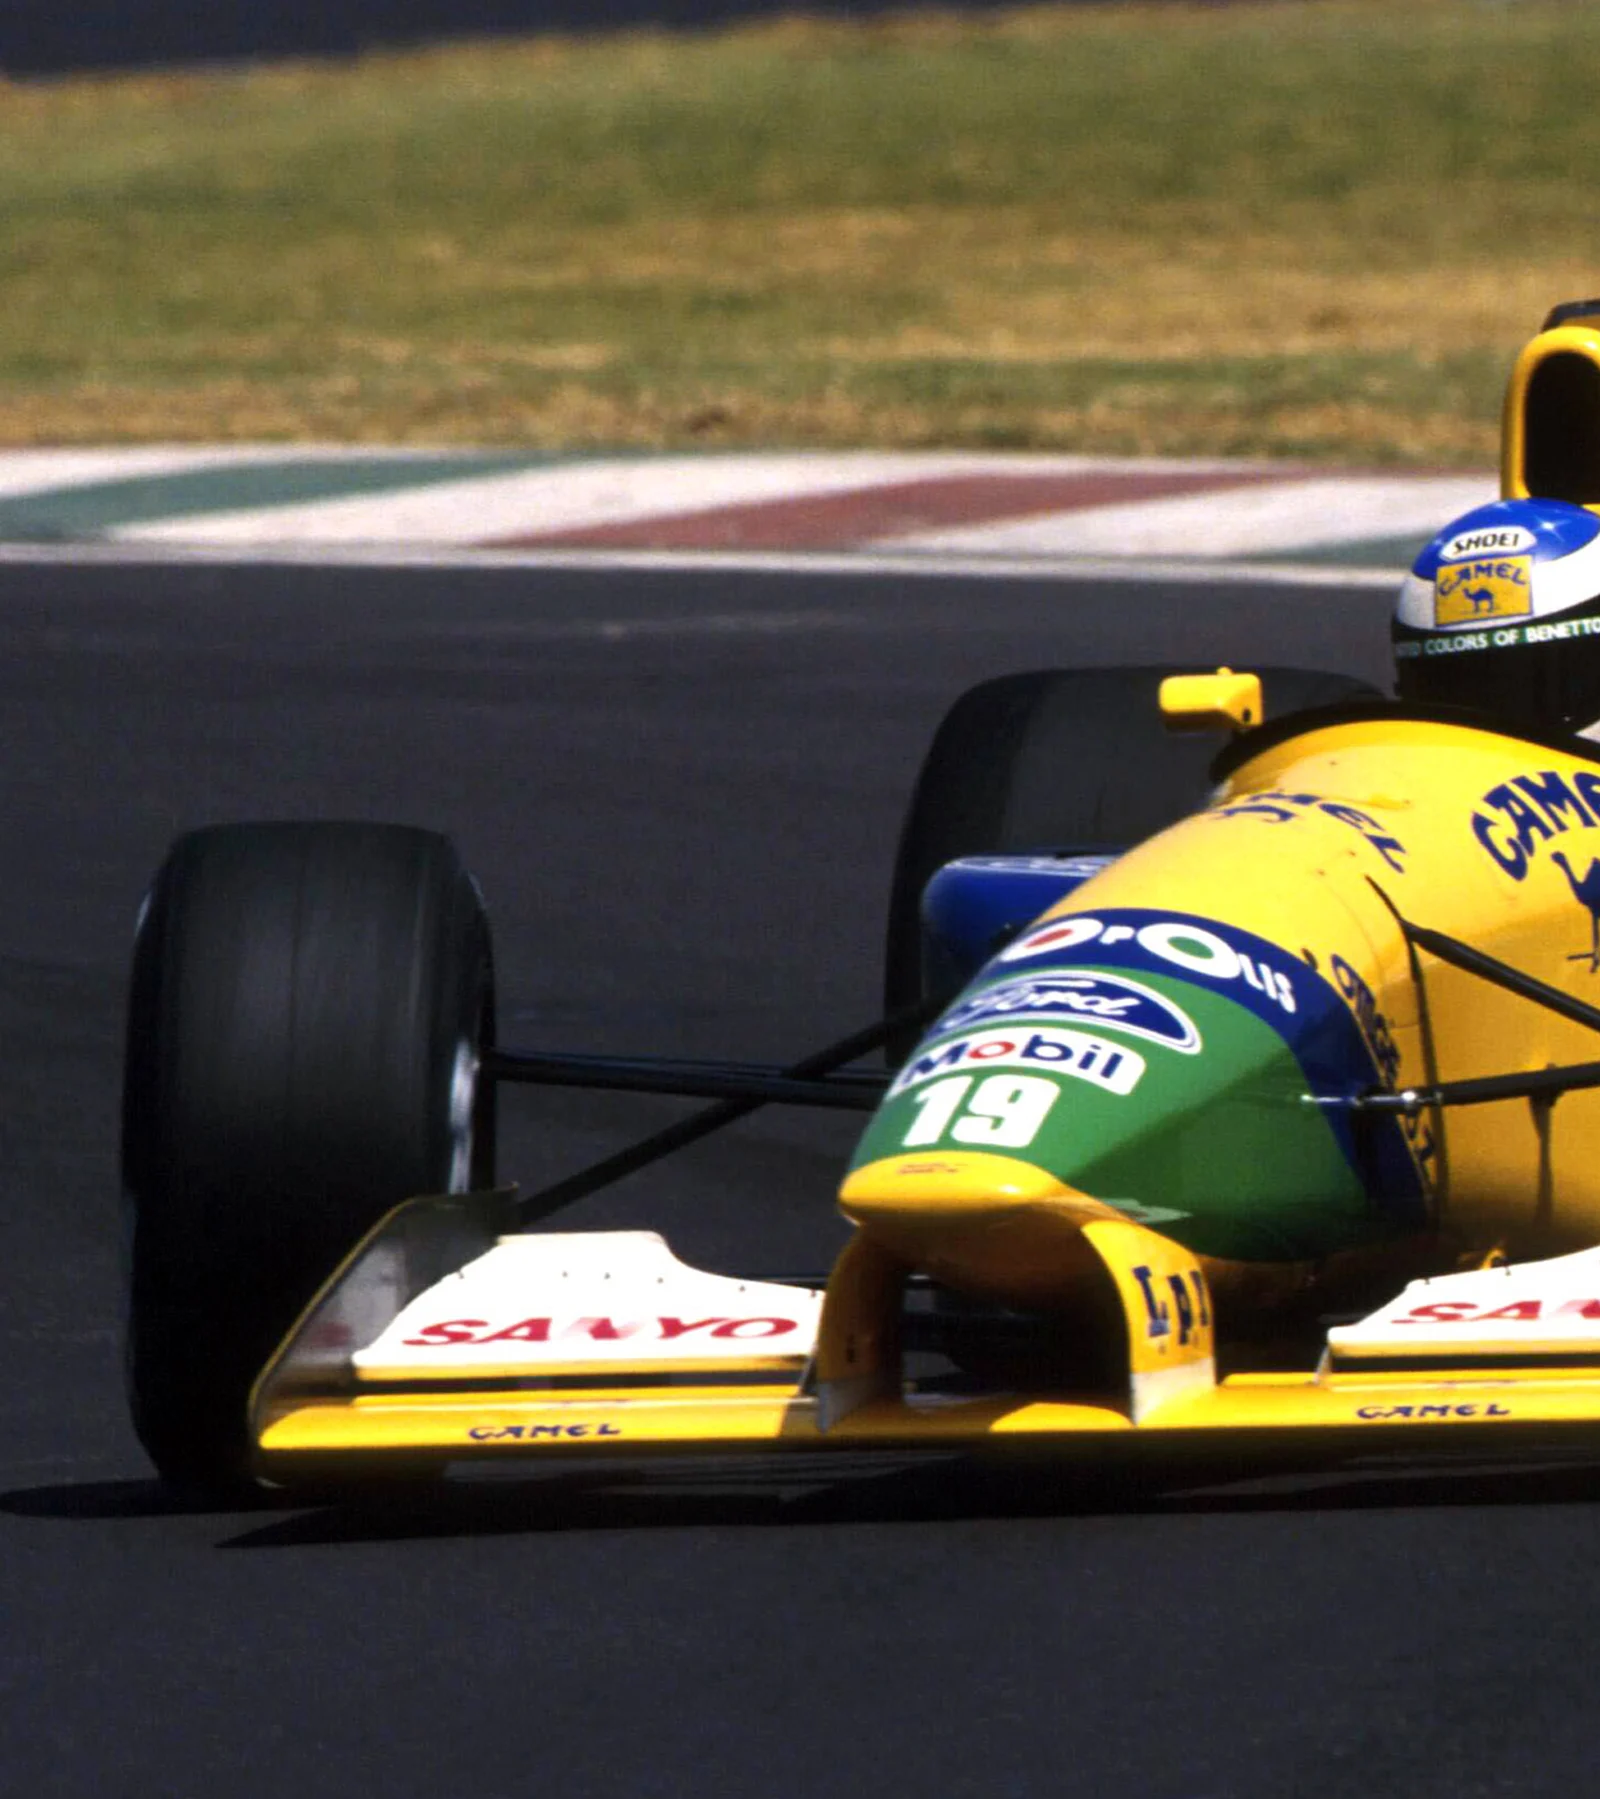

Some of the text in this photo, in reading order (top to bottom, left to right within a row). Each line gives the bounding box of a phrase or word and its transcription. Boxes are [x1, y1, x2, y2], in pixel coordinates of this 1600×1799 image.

[1452, 533, 1519, 555] SHOEI
[1440, 562, 1528, 596] CAMEL
[1424, 633, 1488, 655] COLORS
[1494, 629, 1519, 647] OF
[942, 979, 1142, 1030] Ford
[903, 1034, 1124, 1085] Mobil
[902, 1073, 1061, 1148] 19
[401, 1316, 799, 1346] SANYO
[1357, 1403, 1511, 1420] CAMEL
[468, 1422, 621, 1440] CAMEL
